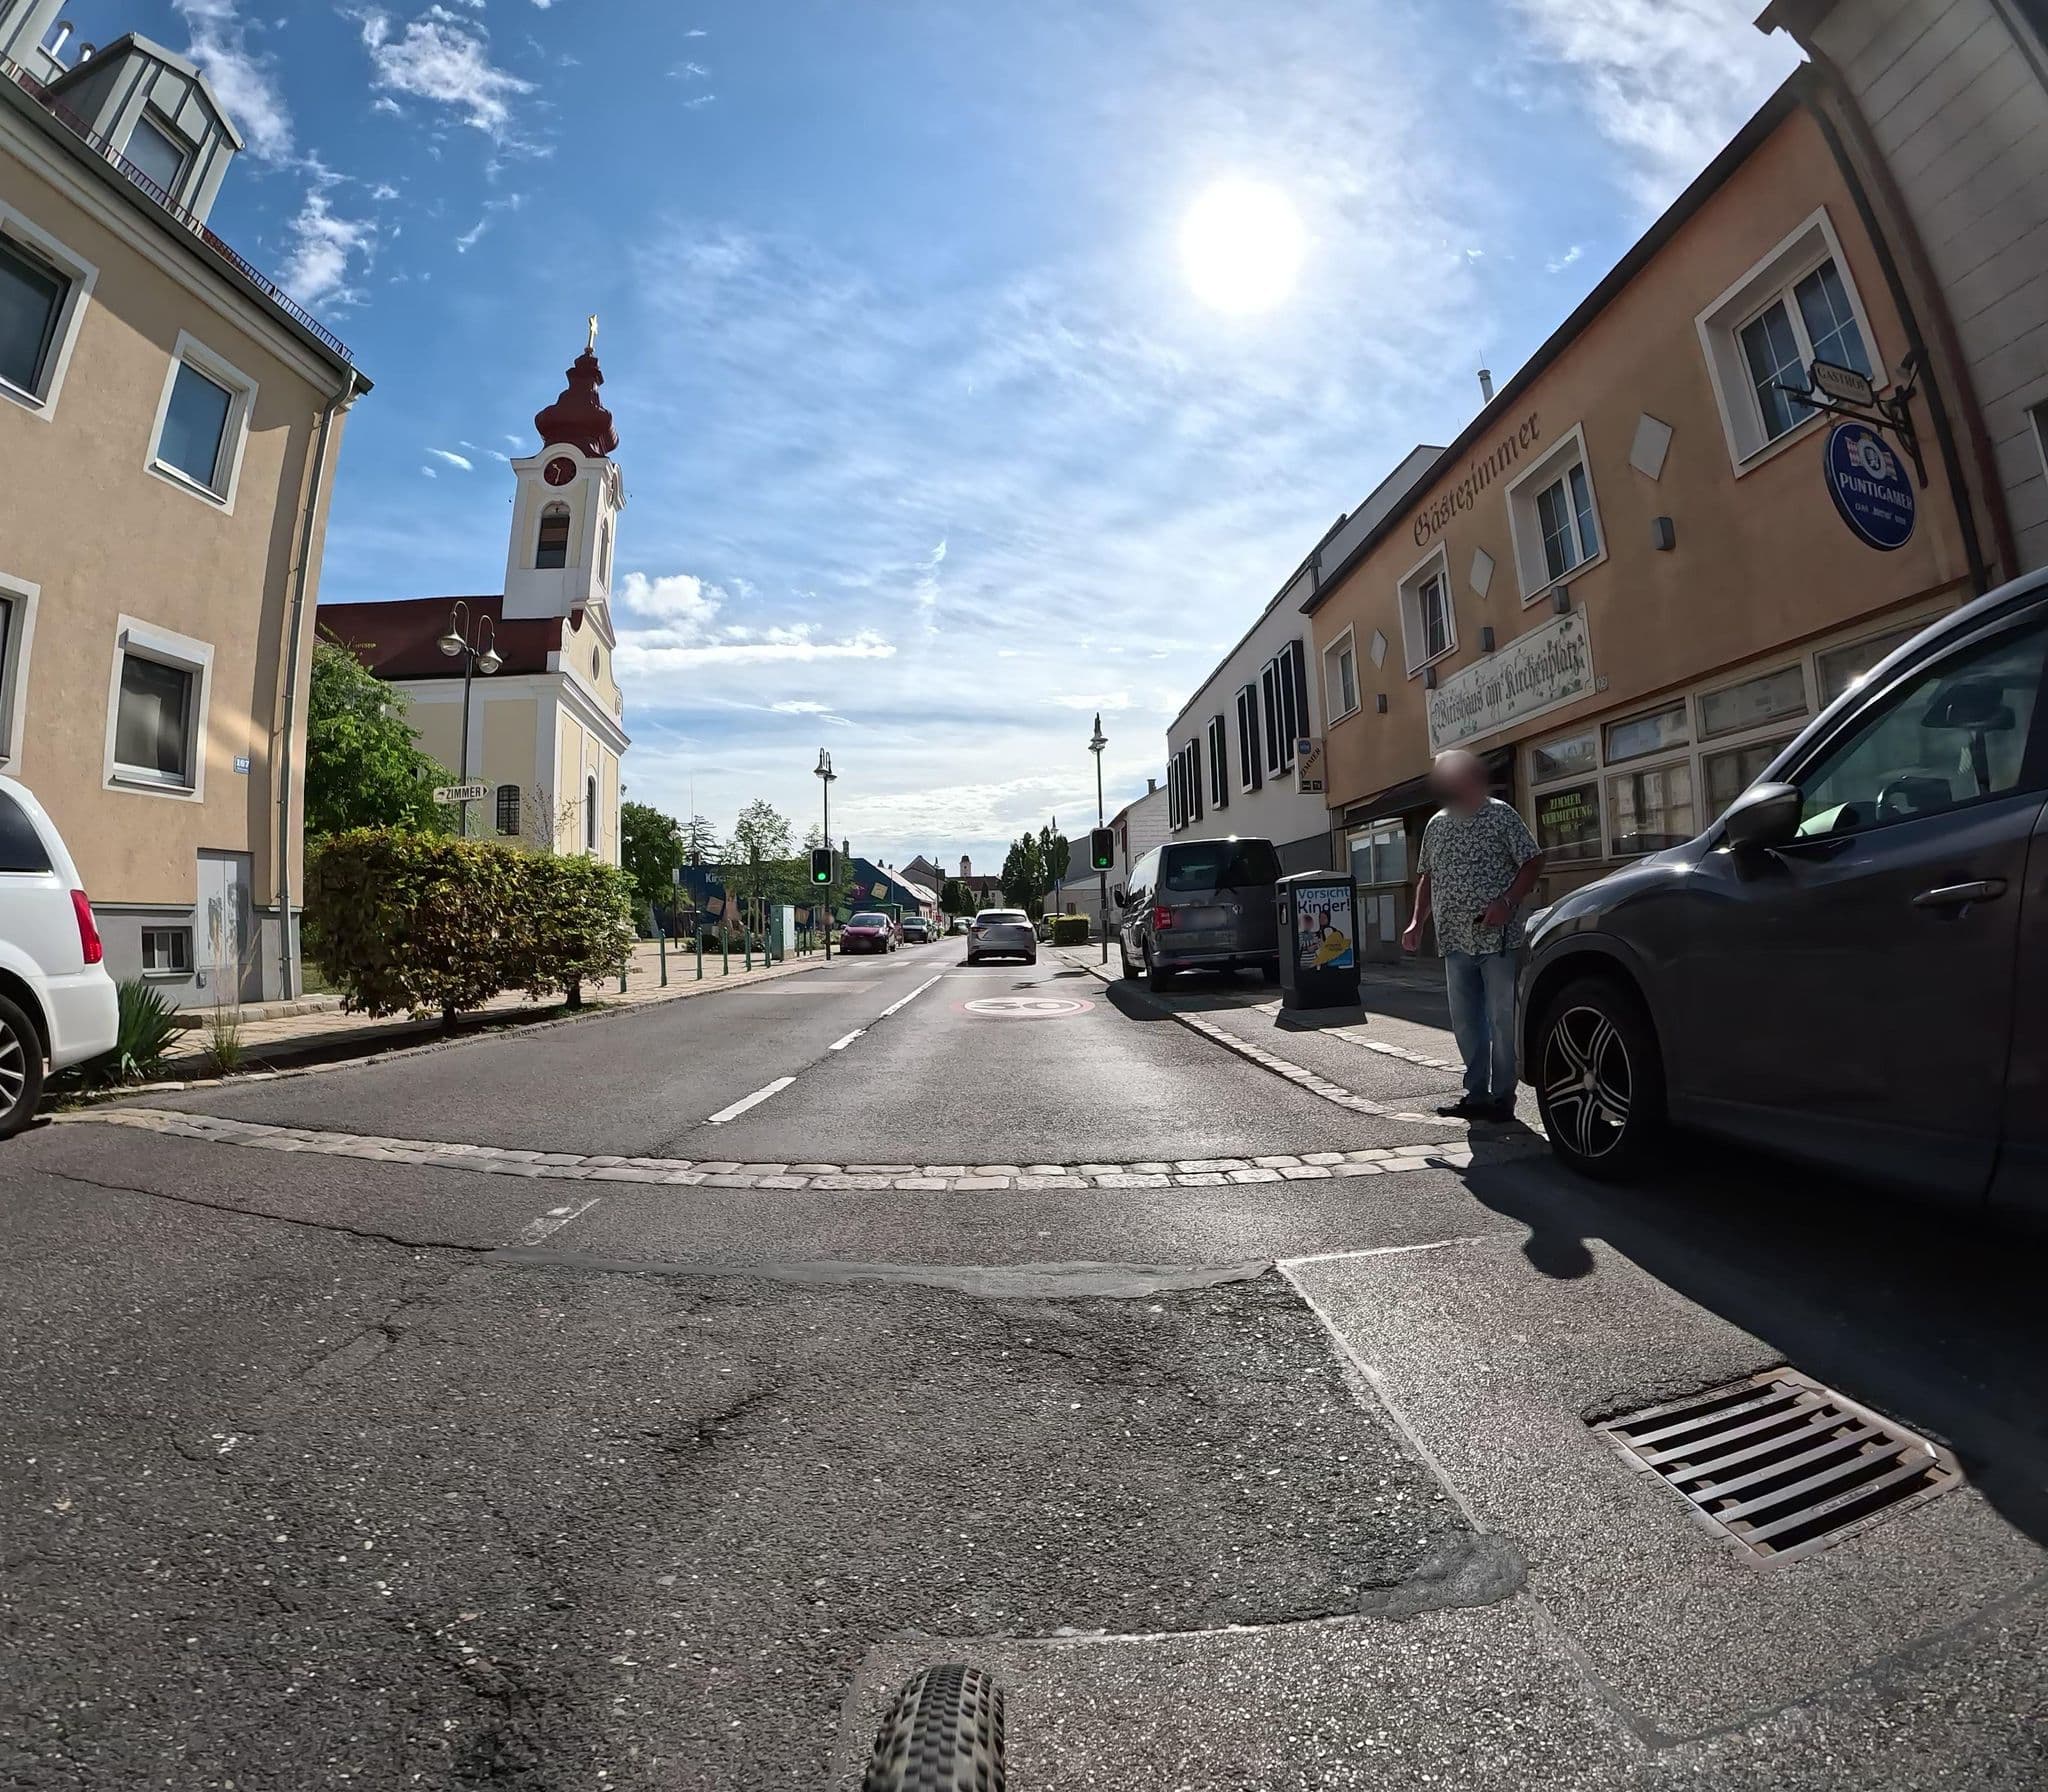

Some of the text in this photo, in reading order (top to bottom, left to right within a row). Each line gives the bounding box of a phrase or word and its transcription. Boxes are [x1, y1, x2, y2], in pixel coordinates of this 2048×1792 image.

[1413, 411, 1541, 547] Gästezimmer
[1839, 472, 1913, 512] PUNTIGAMER
[1486, 680, 1503, 708] am
[1505, 640, 1582, 699] Kirchenplatz
[446, 786, 481, 800] ZIMMER
[1550, 793, 1582, 810] ZIMMER
[1541, 804, 1593, 825] VERMIETUNG
[1298, 887, 1350, 899] Vorsicht
[1298, 899, 1351, 914] Kinder!
